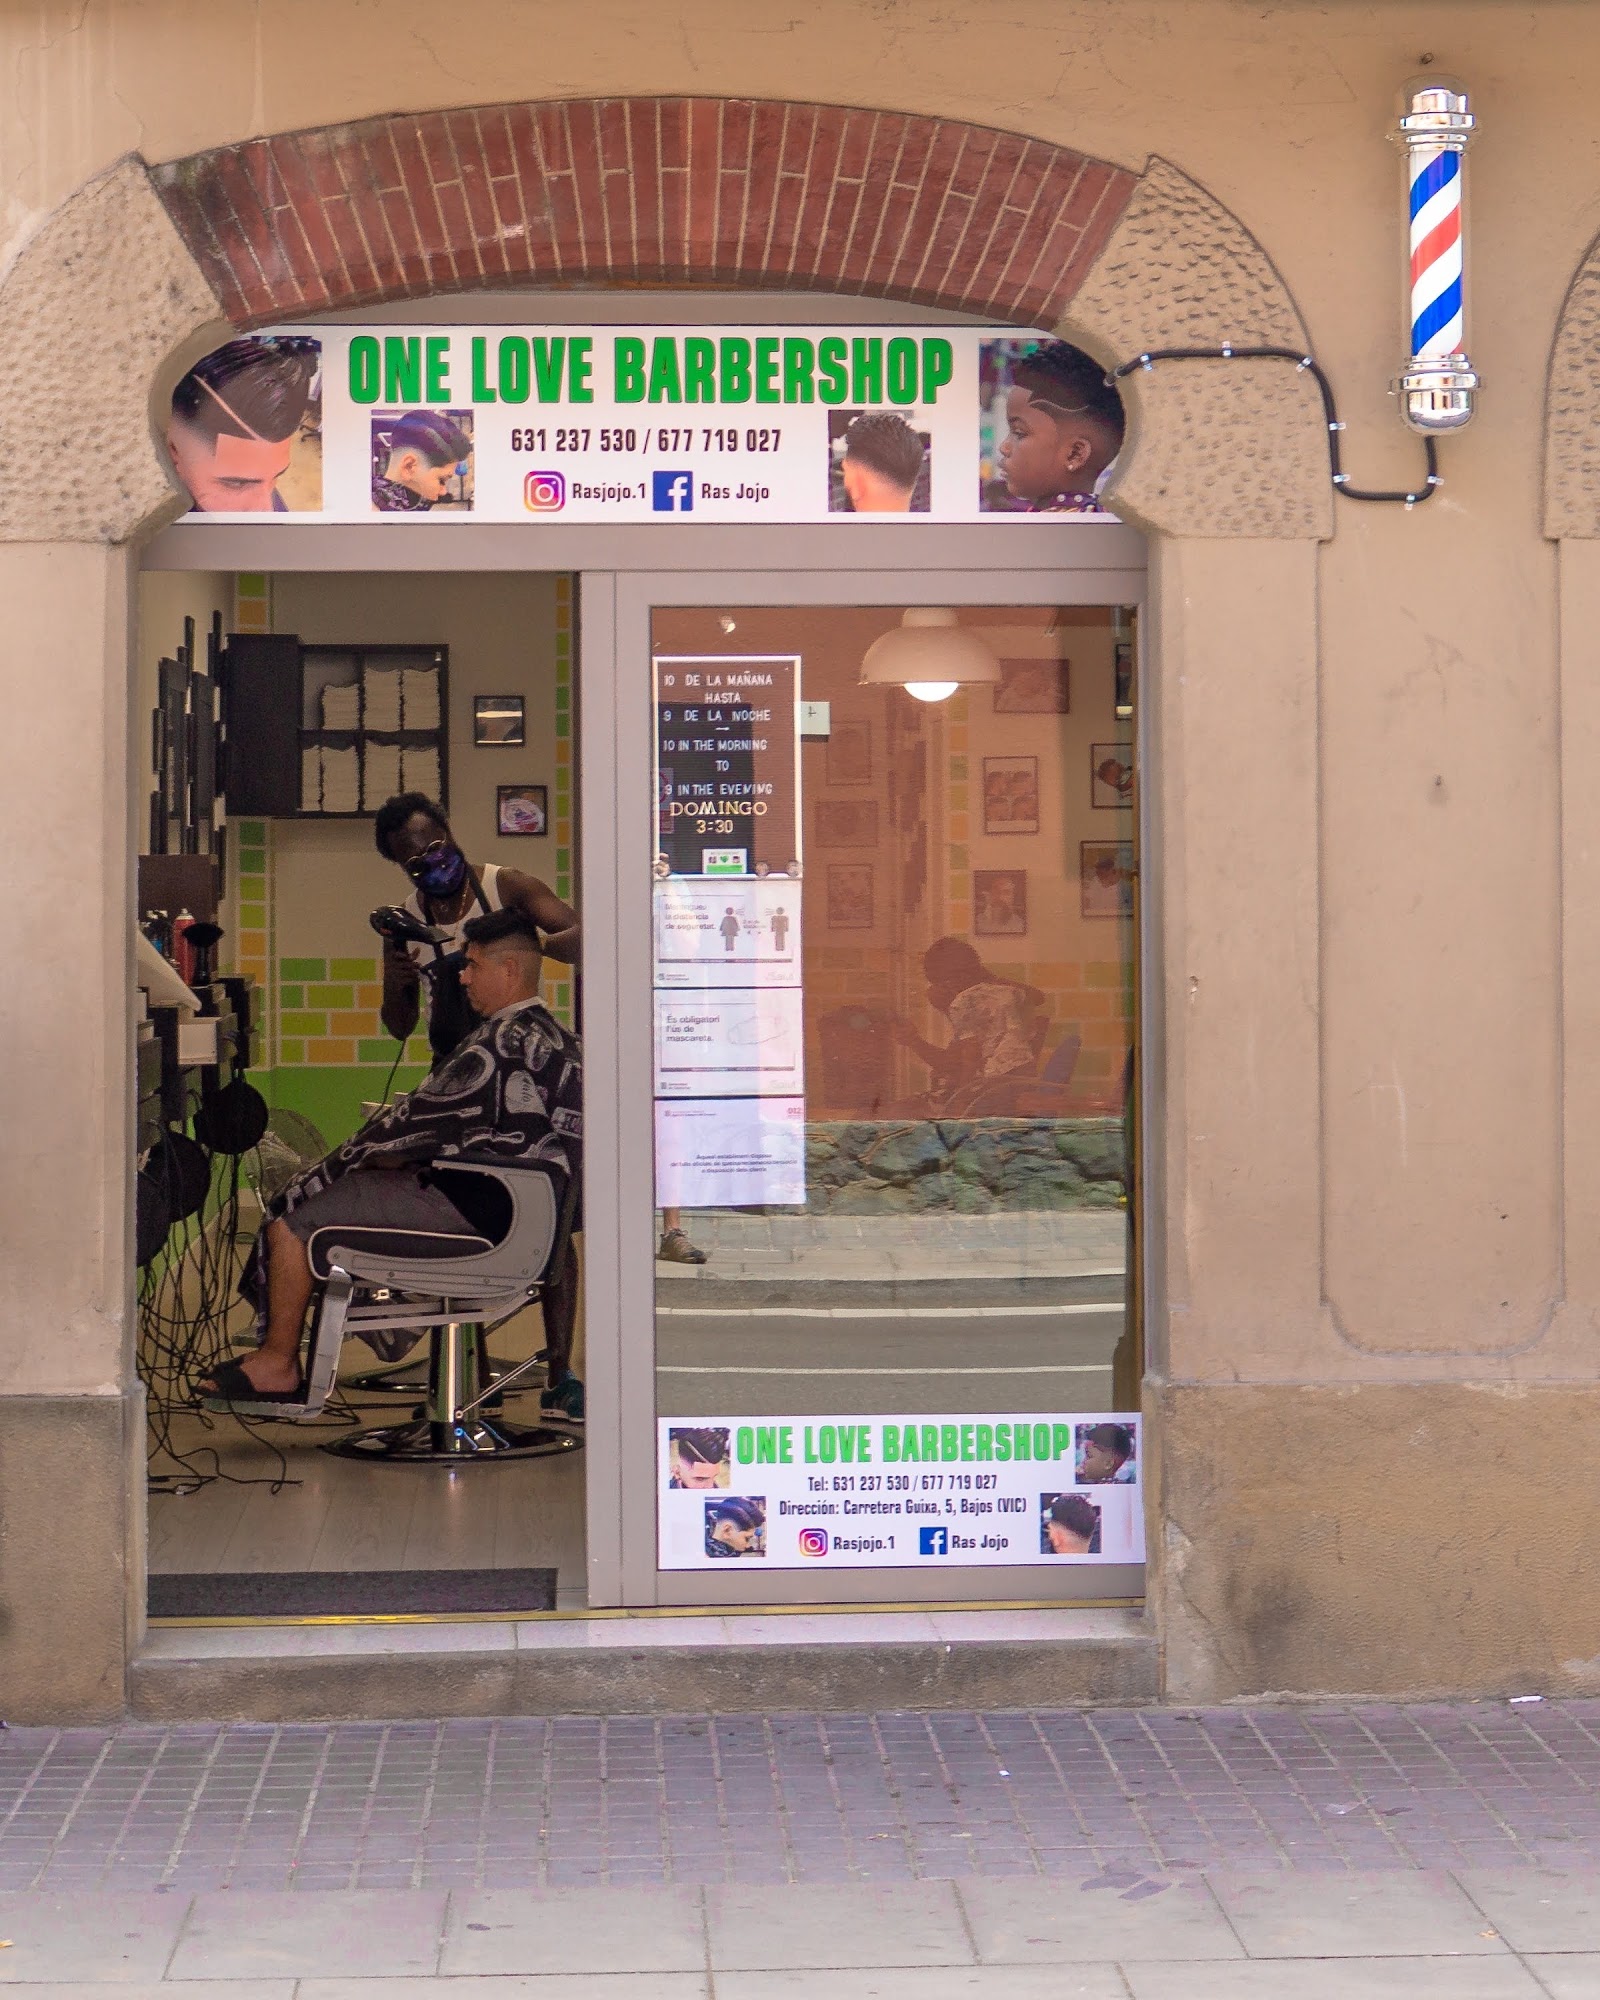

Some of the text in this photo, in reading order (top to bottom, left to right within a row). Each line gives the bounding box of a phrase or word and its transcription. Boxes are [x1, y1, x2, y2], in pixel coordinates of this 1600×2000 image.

[349, 336, 953, 405] ONE LOVE BARBERSHOP
[511, 428, 782, 454] 631 237 530 / 677 719 027
[572, 483, 646, 503] Rasjojo.1
[701, 483, 730, 499] Ras
[736, 482, 770, 503] Jojo
[663, 670, 773, 686] 10 DE LA MAÑANA
[705, 692, 742, 704] HASTA
[663, 709, 771, 721] 9 DE LA NOCHE
[663, 739, 768, 751] 10 IN THE MORNING
[715, 760, 730, 772] TO
[665, 784, 673, 795] 9
[677, 784, 690, 796] IN
[692, 784, 714, 796] THE
[669, 800, 768, 817] DOMINGO
[679, 1014, 720, 1025] obligatori
[684, 1025, 694, 1033] de
[736, 1423, 1071, 1464] ONE LOVE BARBERSHOP
[808, 1474, 997, 1491] Tel: 631 237 530 / 677 719 027
[779, 1497, 1027, 1517] Dirección: Carretera Guixa, 5, Bajos (VIC)
[833, 1536, 895, 1552] Rasjojo.1
[952, 1535, 976, 1548] Ras
[980, 1534, 1009, 1551] Jojo
